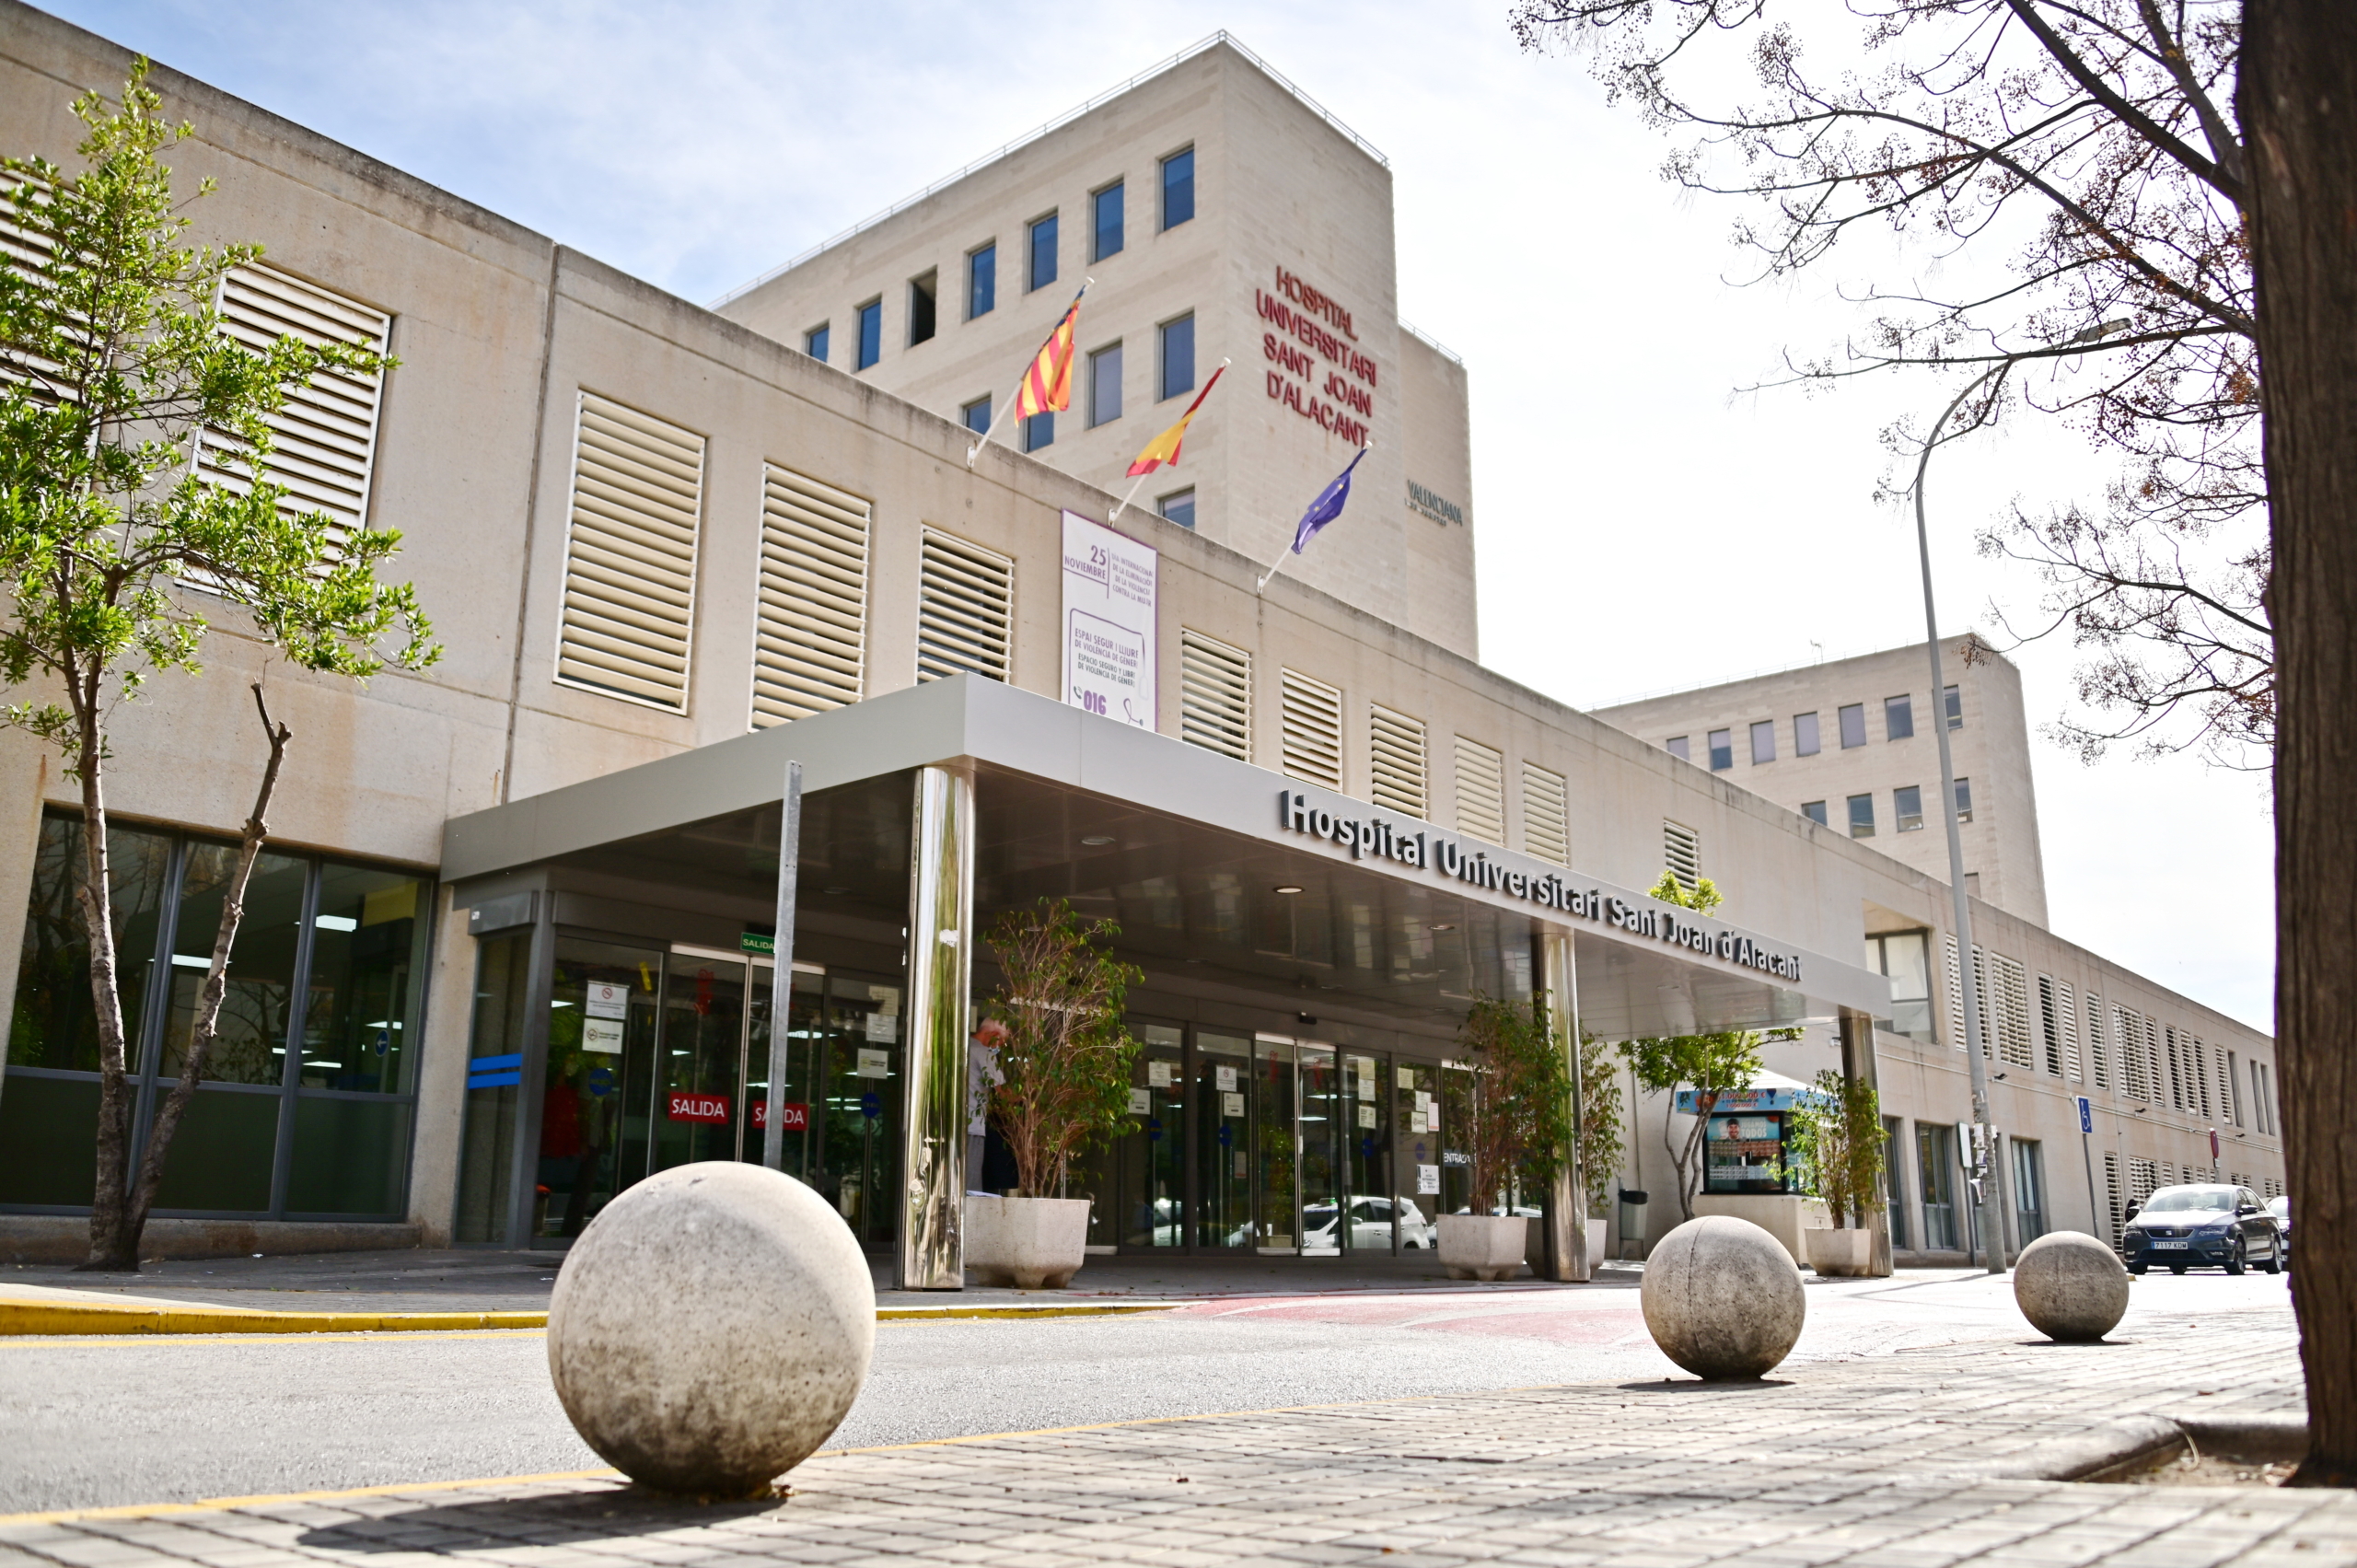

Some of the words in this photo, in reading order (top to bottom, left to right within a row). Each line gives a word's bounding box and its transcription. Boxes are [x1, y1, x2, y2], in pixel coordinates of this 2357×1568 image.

[1276, 265, 1358, 342] HOSPITAL
[1256, 288, 1376, 388] UNIVERSITARI
[1264, 332, 1315, 382] SANT
[1324, 371, 1372, 418] JOAN
[1267, 370, 1369, 449] D'ALACANT
[1407, 479, 1462, 527] VALENCIANA
[1090, 545, 1107, 566] 25
[1064, 555, 1107, 579] NOVIEMBRE
[1112, 563, 1118, 572] DE
[1119, 566, 1124, 575] LA
[1115, 575, 1120, 583] DE
[1112, 585, 1130, 598] CONTRA
[1131, 592, 1136, 600] LA
[1074, 628, 1092, 642] ESPAI
[1094, 634, 1113, 650] SEGUR
[1119, 644, 1139, 659] LLIURE
[1074, 639, 1081, 648] DE
[1111, 653, 1119, 662] DE
[1078, 653, 1097, 666] ESPACIO
[1098, 660, 1117, 673] SEGURO
[1086, 664, 1109, 679] VIOLENCIA
[1111, 673, 1117, 681] DE
[1084, 690, 1107, 715] 016
[1282, 788, 1428, 869] Hospital
[1437, 838, 1602, 921] Universitari
[1607, 894, 1664, 939] Sant
[1664, 912, 1715, 956] Joan
[1718, 929, 1803, 981] d'Alacant
[742, 938, 774, 949] SALIDA
[672, 1099, 725, 1118] SALIDA
[755, 1108, 804, 1124] SADA
[1741, 1128, 1767, 1138] TODOS
